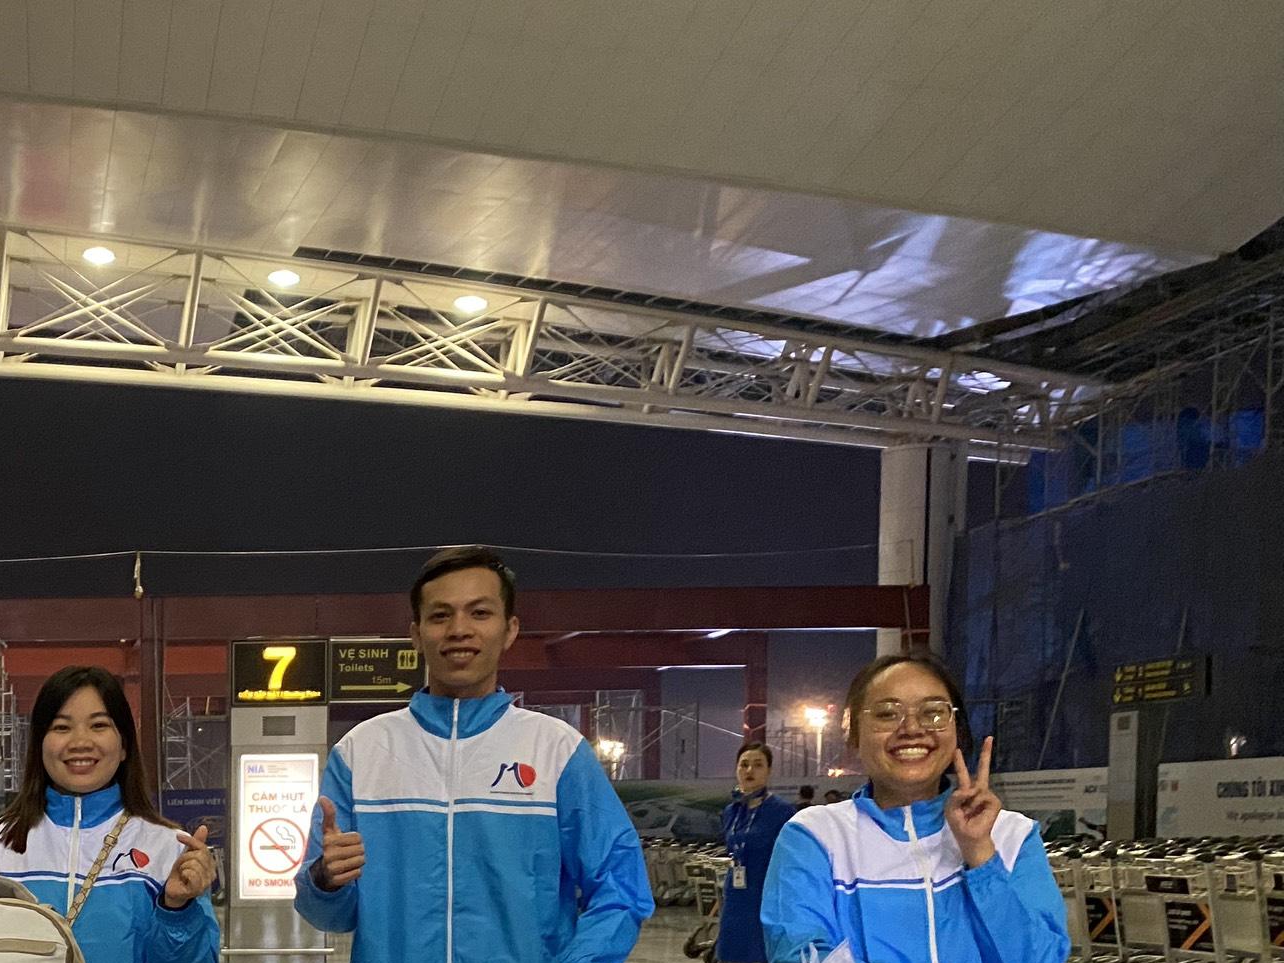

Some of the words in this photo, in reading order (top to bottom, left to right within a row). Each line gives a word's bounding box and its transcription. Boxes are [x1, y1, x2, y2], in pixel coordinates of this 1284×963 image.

[358, 648, 389, 659] SINH
[262, 646, 297, 690] 7
[338, 663, 374, 672] Toilets
[372, 675, 392, 684] 15m
[248, 878, 262, 888] NO
[264, 878, 294, 888] SMOKI
